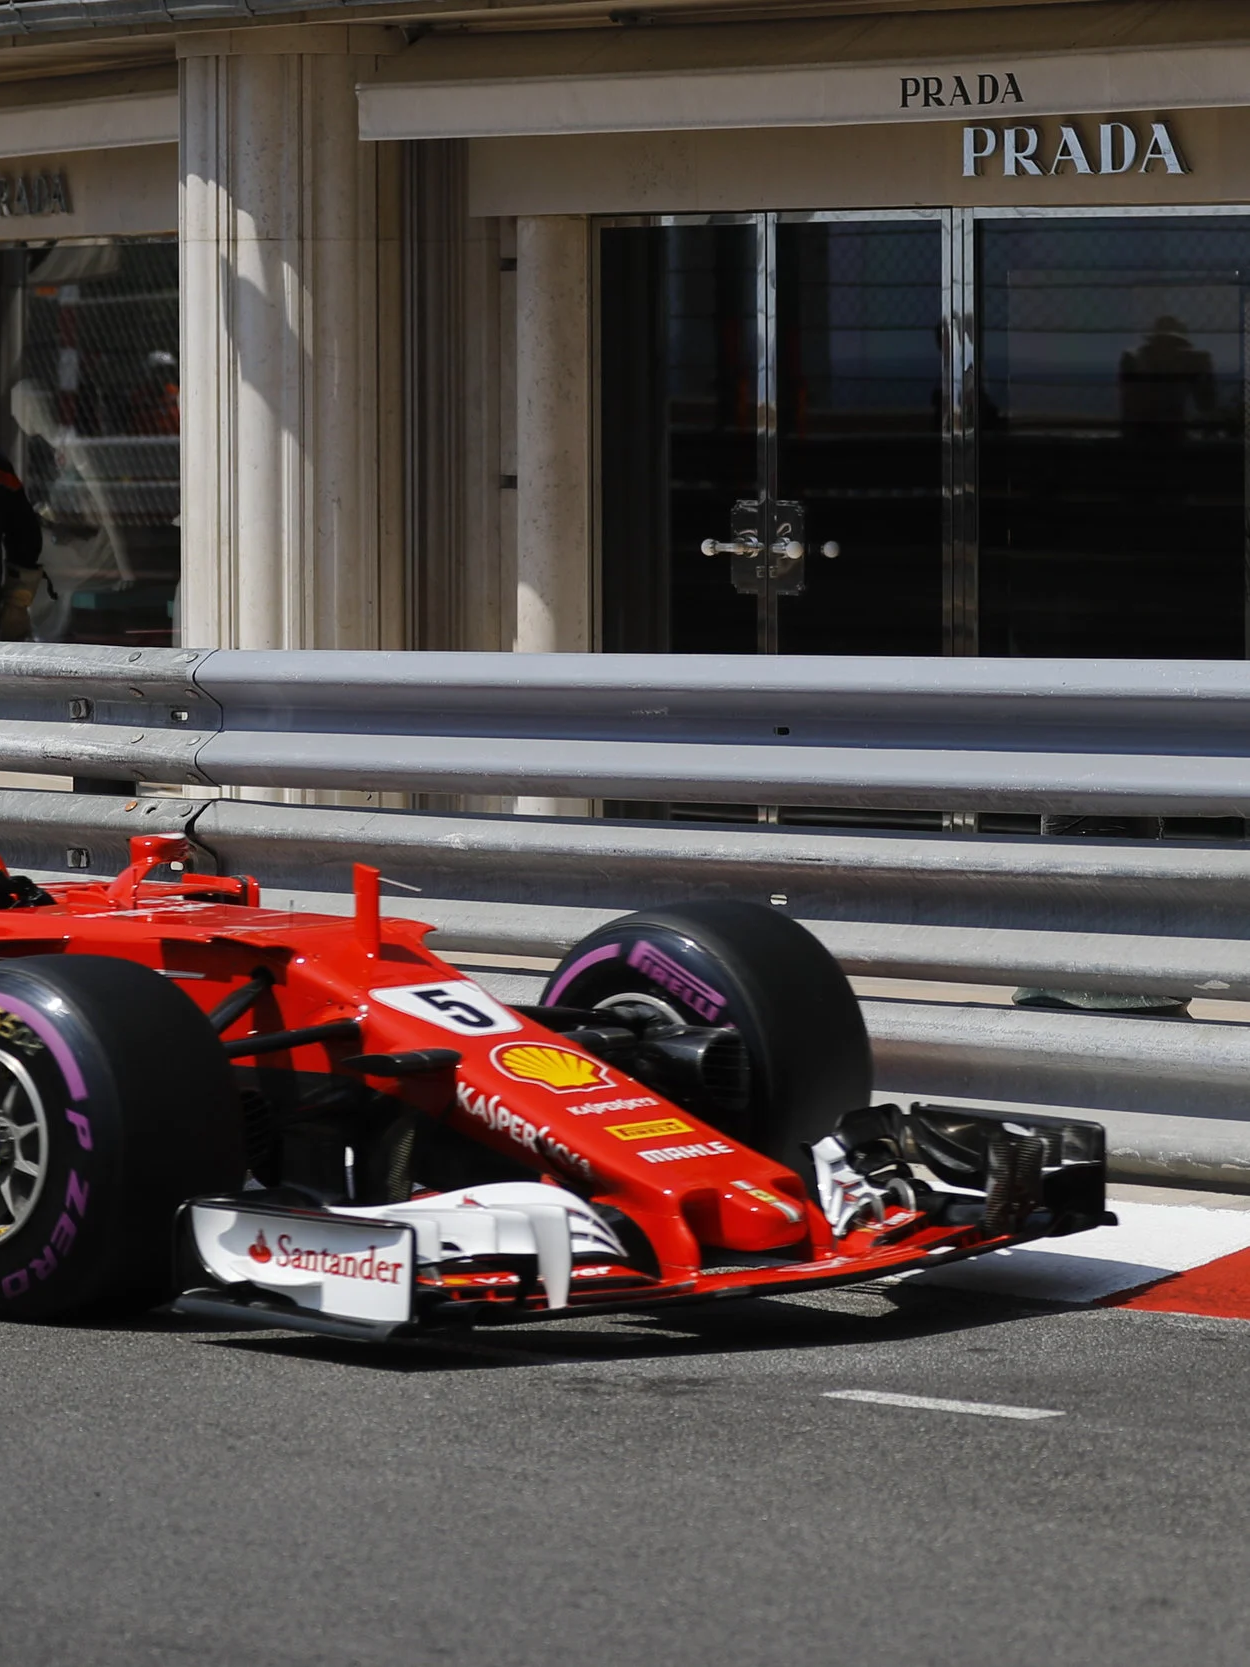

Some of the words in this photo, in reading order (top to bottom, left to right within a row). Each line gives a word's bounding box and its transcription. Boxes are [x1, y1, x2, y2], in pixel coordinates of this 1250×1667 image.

[899, 72, 1025, 108] PRADA
[961, 121, 1188, 177] PRADA
[626, 939, 727, 1022] PIRELLI
[409, 988, 496, 1029] 5
[65, 1108, 94, 1150] P
[615, 1121, 684, 1138] PIRELLI
[636, 1141, 736, 1163] MAHLE
[1, 1169, 90, 1298] ZERO
[276, 1233, 404, 1284] Santander
